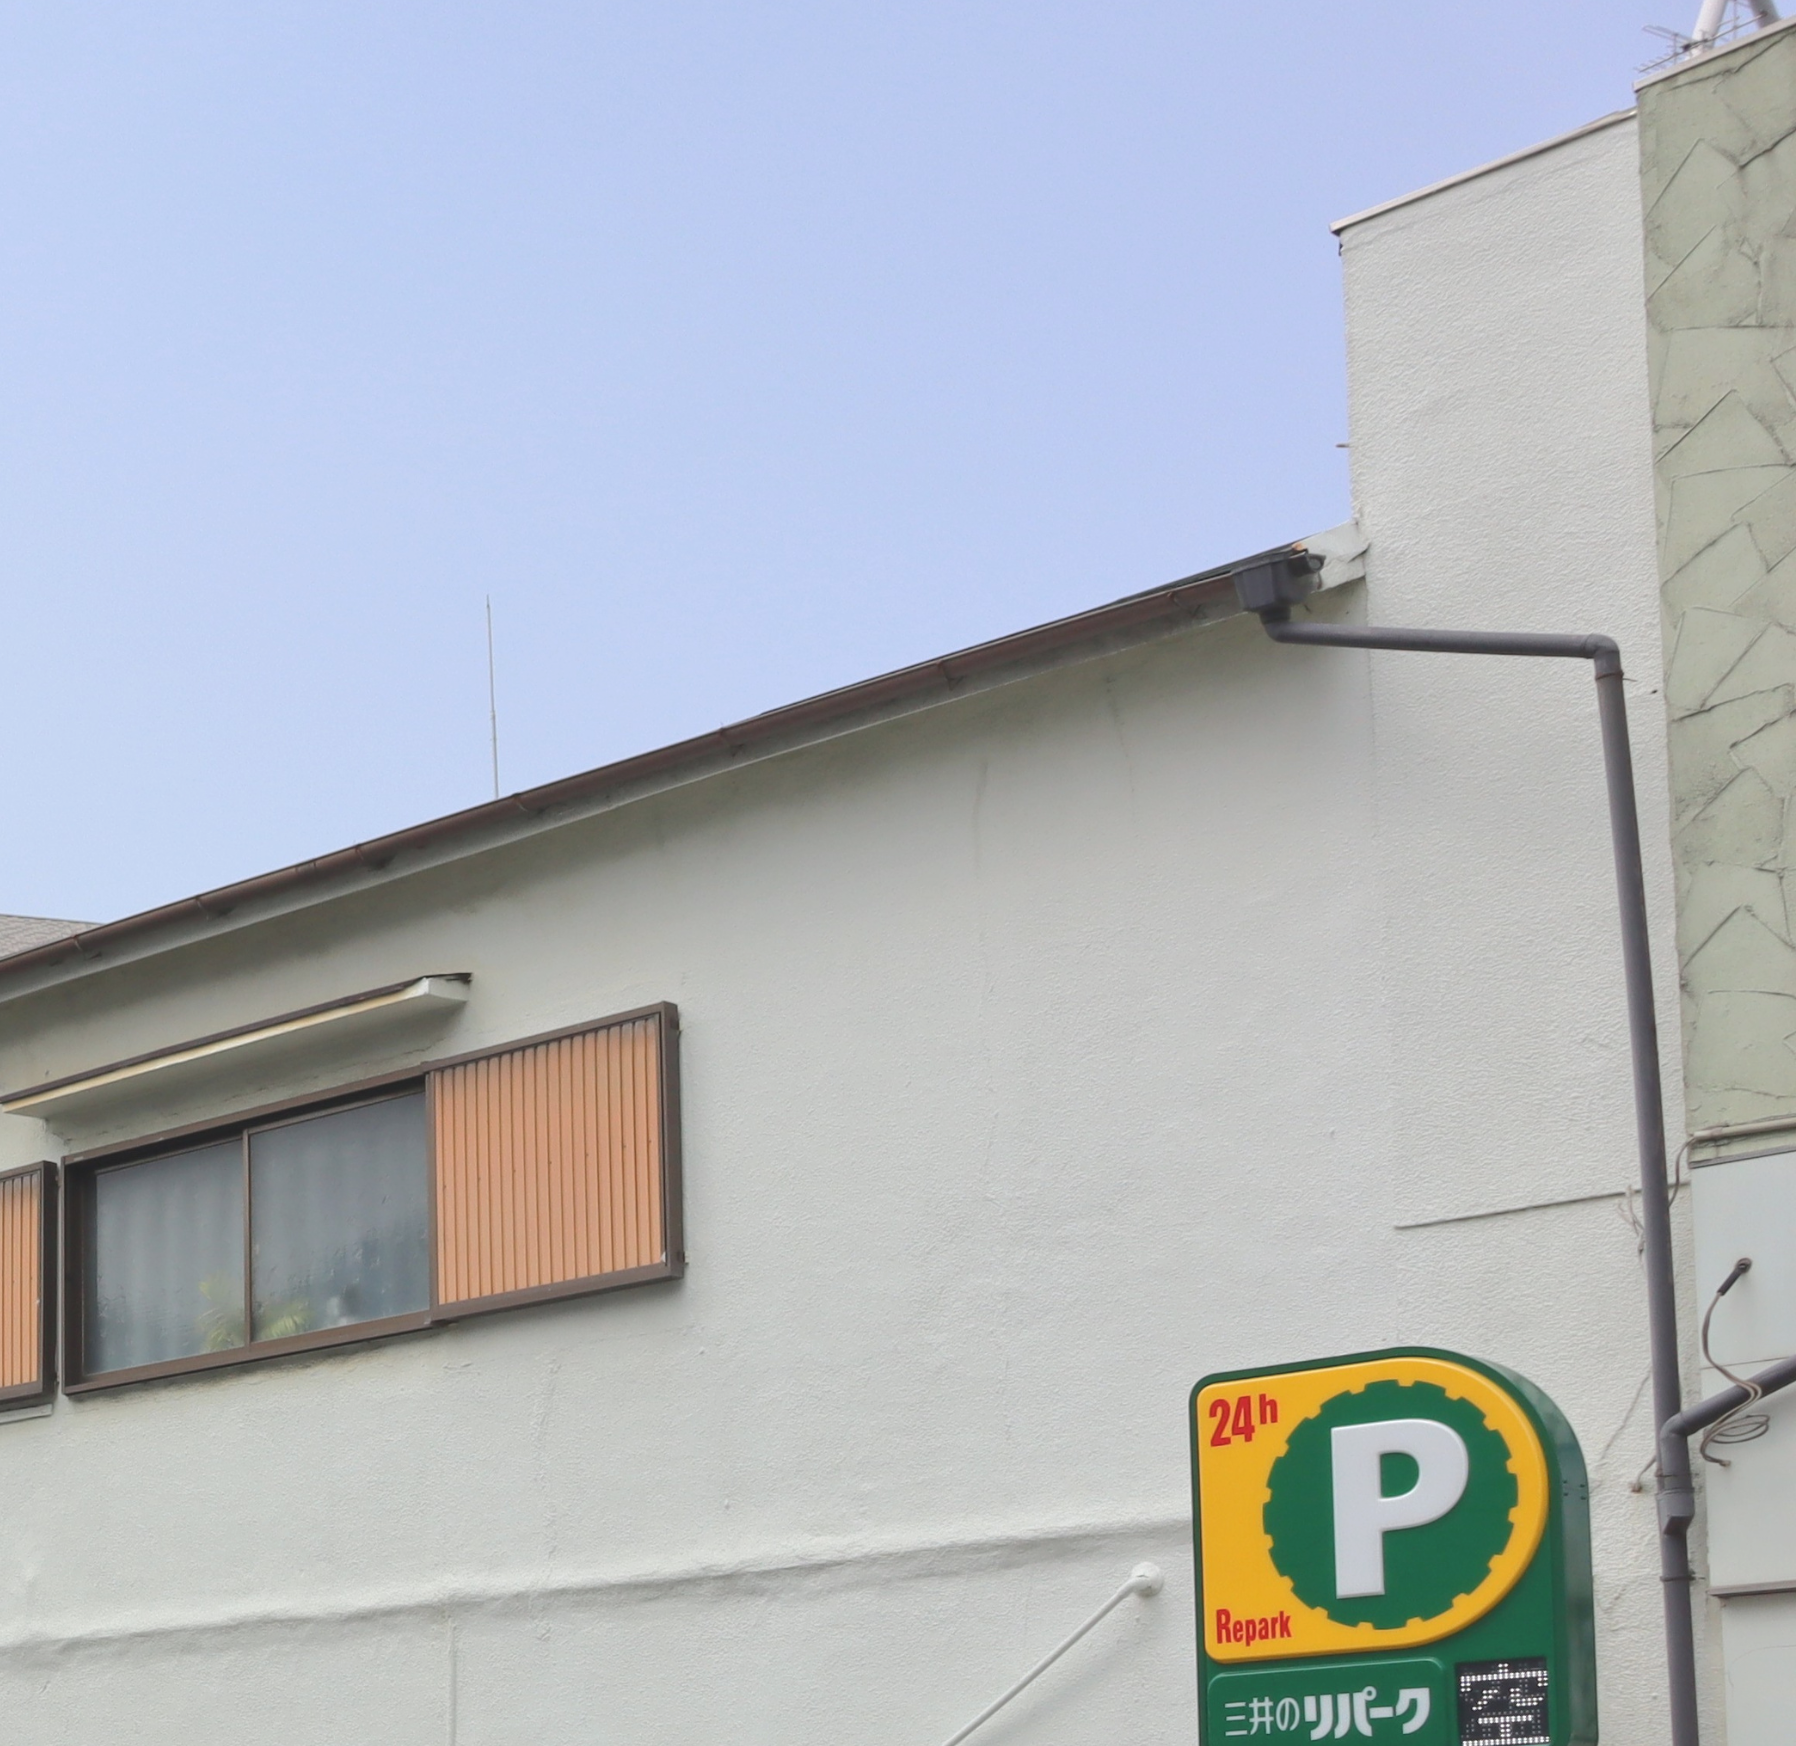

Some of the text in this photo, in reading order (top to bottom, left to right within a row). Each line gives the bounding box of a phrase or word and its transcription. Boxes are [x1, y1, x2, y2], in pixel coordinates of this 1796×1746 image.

[1209, 1393, 1278, 1447] 24h
[1330, 1418, 1469, 1599] P
[1216, 1608, 1292, 1646] Repark
[1225, 1686, 1431, 1741] 三井のリパーク
